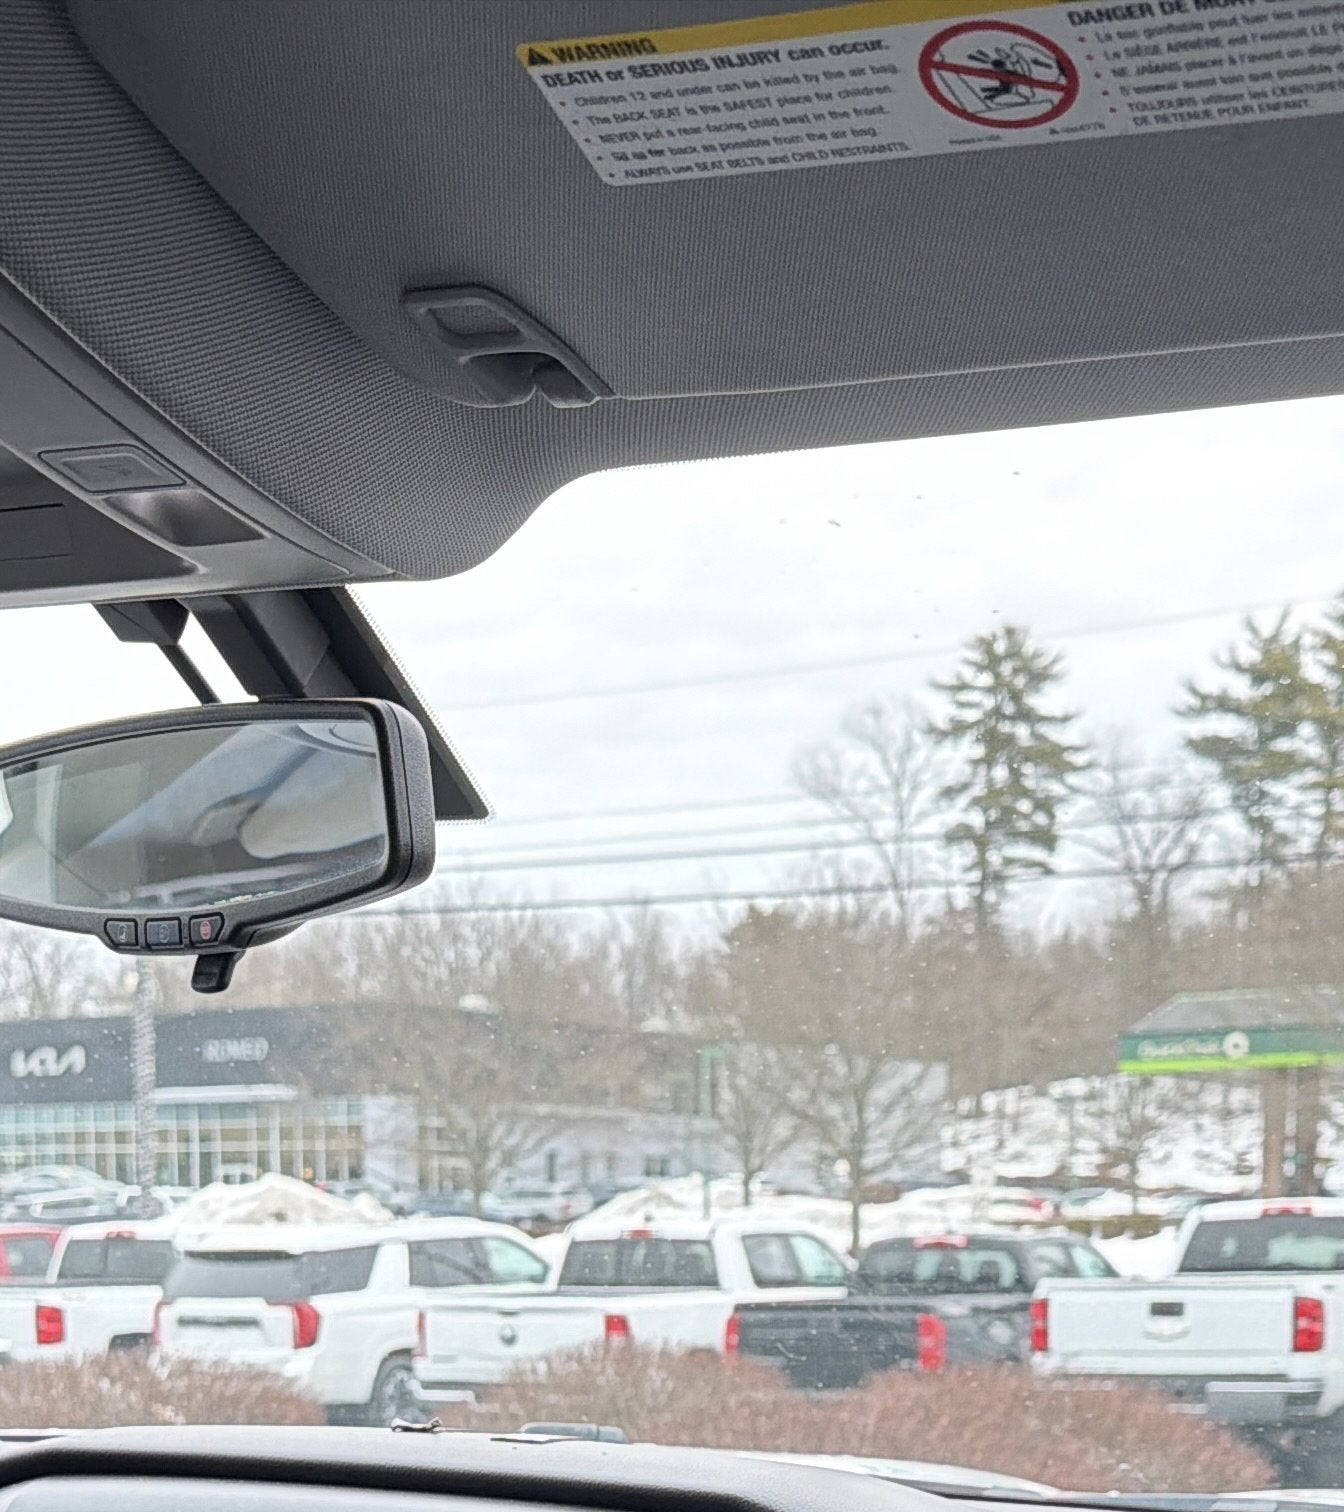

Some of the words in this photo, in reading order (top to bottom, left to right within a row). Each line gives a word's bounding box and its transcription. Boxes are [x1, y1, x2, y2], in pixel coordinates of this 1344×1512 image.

[551, 38, 657, 63] WARNING
[541, 69, 602, 88] DEATH
[607, 69, 625, 81] or
[628, 58, 710, 79] SERIOUS
[712, 49, 781, 70] INJURY
[788, 46, 824, 61] can
[829, 39, 890, 56] occur.
[630, 91, 646, 101] 12
[650, 88, 673, 99] and
[613, 111, 649, 124] BACK
[650, 107, 681, 119] SEAT
